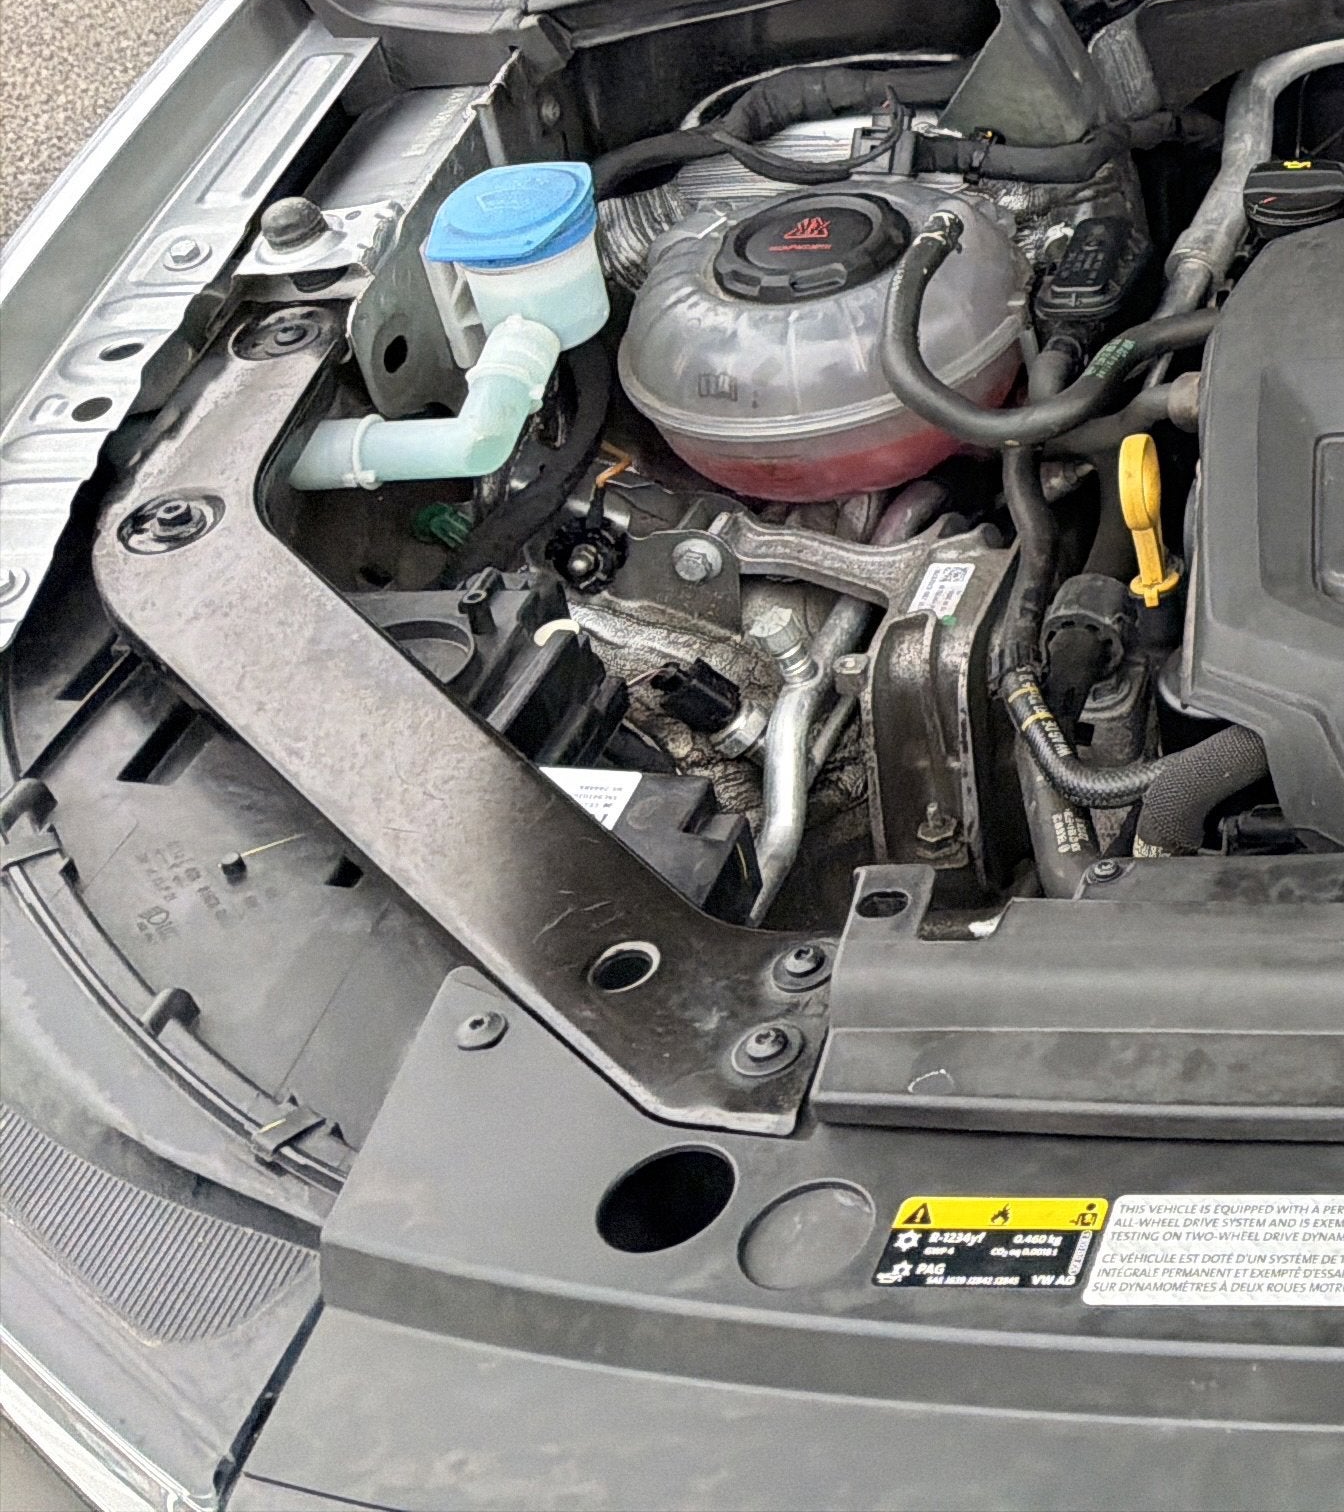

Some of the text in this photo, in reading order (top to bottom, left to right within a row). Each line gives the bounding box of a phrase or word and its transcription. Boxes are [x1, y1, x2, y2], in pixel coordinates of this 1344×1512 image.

[1119, 1203, 1146, 1215] THIS
[1148, 1203, 1198, 1215] VEHICLE
[1198, 1204, 1212, 1215] IS
[1212, 1204, 1275, 1216] EQUIPPED
[1276, 1204, 1310, 1216] WITH
[1310, 1204, 1320, 1215] A
[1112, 1217, 1180, 1228] ALL-WHEEL
[1181, 1217, 1220, 1228] DRIVE
[1221, 1217, 1267, 1228] SYSTEM
[1267, 1218, 1297, 1228] AND
[1298, 1218, 1311, 1229] IS
[928, 1232, 986, 1247] R-1234yf
[1047, 1234, 1063, 1246] kg
[1109, 1231, 1161, 1242] TESTING
[1161, 1231, 1183, 1242] ON
[1184, 1231, 1261, 1242] TWO-WHEEL
[1261, 1231, 1300, 1242] DRIVE
[1101, 1252, 1119, 1264] CE
[1119, 1251, 1177, 1264] VÉHICULE
[1177, 1252, 1201, 1264] EST
[1200, 1252, 1235, 1264] DOTÉ
[1234, 1252, 1268, 1265] D'UN
[1267, 1252, 1321, 1265] SYSTÈME
[1319, 1253, 1339, 1265] DE
[915, 1263, 946, 1275] PAG
[1096, 1266, 1161, 1278] INTÉGRALE
[1160, 1266, 1235, 1278] PERMANENT
[1232, 1267, 1250, 1279] ET
[1248, 1266, 1303, 1279] EXEMPTÉ
[1031, 1275, 1054, 1285] VW
[1055, 1275, 1076, 1285] AG
[1090, 1281, 1118, 1293] SUR
[1117, 1280, 1218, 1293] DYNAMOMÈTRES
[1217, 1280, 1228, 1292] À
[1229, 1281, 1265, 1293] DEUX
[1265, 1281, 1307, 1293] ROUES
